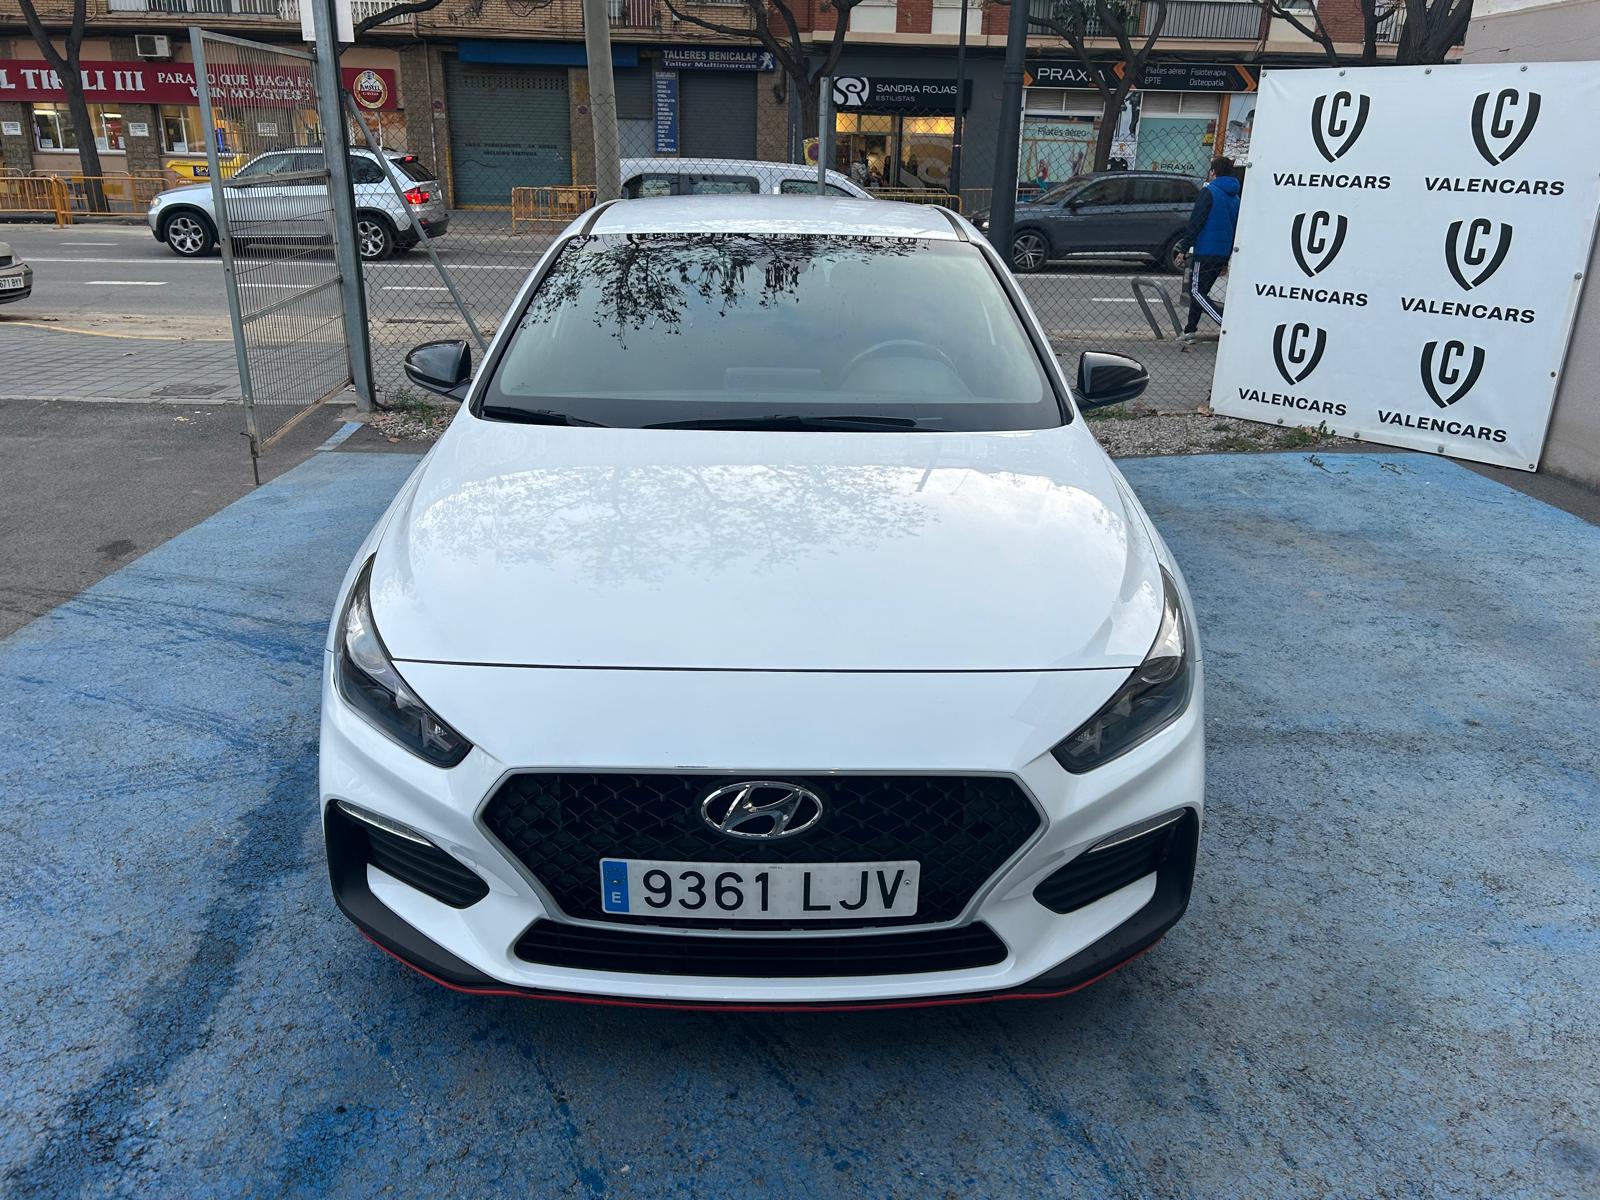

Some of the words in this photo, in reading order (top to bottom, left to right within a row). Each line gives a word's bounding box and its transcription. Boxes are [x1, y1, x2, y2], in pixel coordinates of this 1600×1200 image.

[663, 49, 707, 60] TALLERES
[709, 50, 758, 62] BENICALAP
[664, 60, 692, 68] Taller
[694, 61, 758, 70] Multimarcas
[157, 72, 195, 84] PARA
[220, 74, 248, 87] QUE
[1144, 76, 1162, 85] EPTE
[876, 83, 920, 93] SANDRA
[922, 84, 958, 95] ROJAS
[875, 95, 916, 103] ESTILISTAS
[1273, 173, 1391, 189] VALENCARS
[1425, 177, 1565, 196] VALENCARS
[1255, 284, 1368, 307] VALENCARS
[1401, 297, 1535, 324] VALENCARS
[1238, 387, 1347, 417] VALENCARS
[1377, 410, 1507, 444] VALENCARS
[611, 891, 621, 904] E
[642, 869, 769, 912] 9361
[802, 869, 905, 912] LJV
